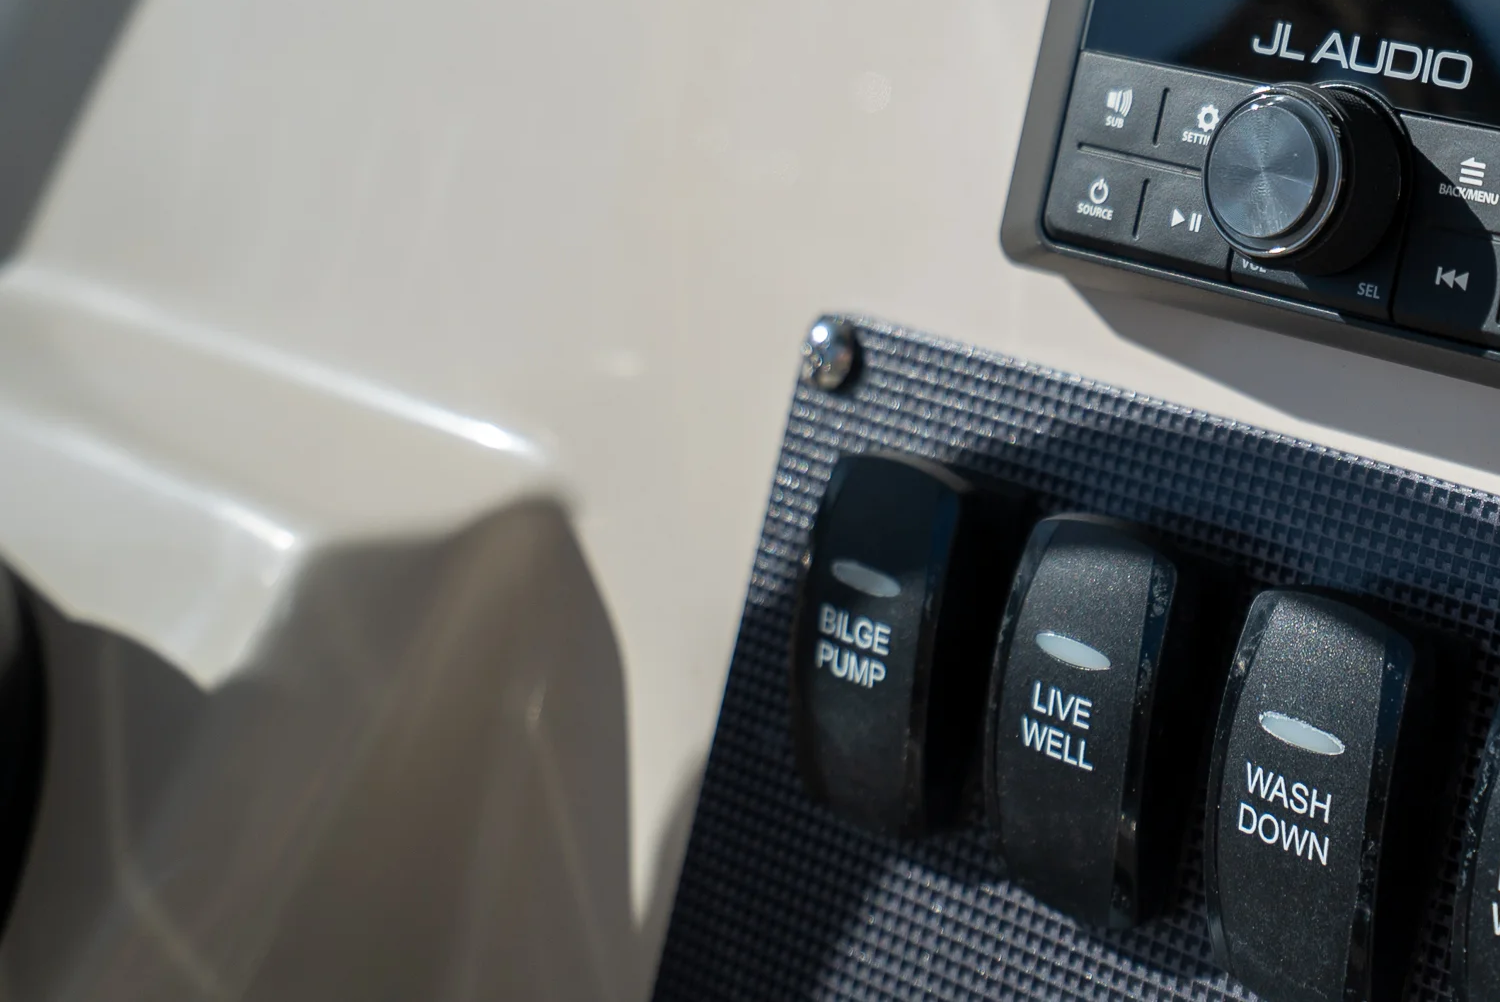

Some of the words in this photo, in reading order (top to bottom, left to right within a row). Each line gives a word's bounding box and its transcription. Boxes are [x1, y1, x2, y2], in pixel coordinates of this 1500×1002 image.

[1253, 22, 1305, 61] JL
[1311, 32, 1473, 90] AUDIO
[1105, 115, 1125, 129] SUB
[1076, 202, 1114, 221] SOURCE
[1438, 183, 1499, 205] BACK/MENU
[1356, 282, 1380, 300] SEL
[819, 605, 891, 656] BILGE
[815, 641, 886, 689] PUMP
[1031, 681, 1092, 730] LIVE
[1021, 716, 1093, 772] WELL
[1246, 762, 1332, 825] WASH
[1237, 811, 1330, 867] DOWN
